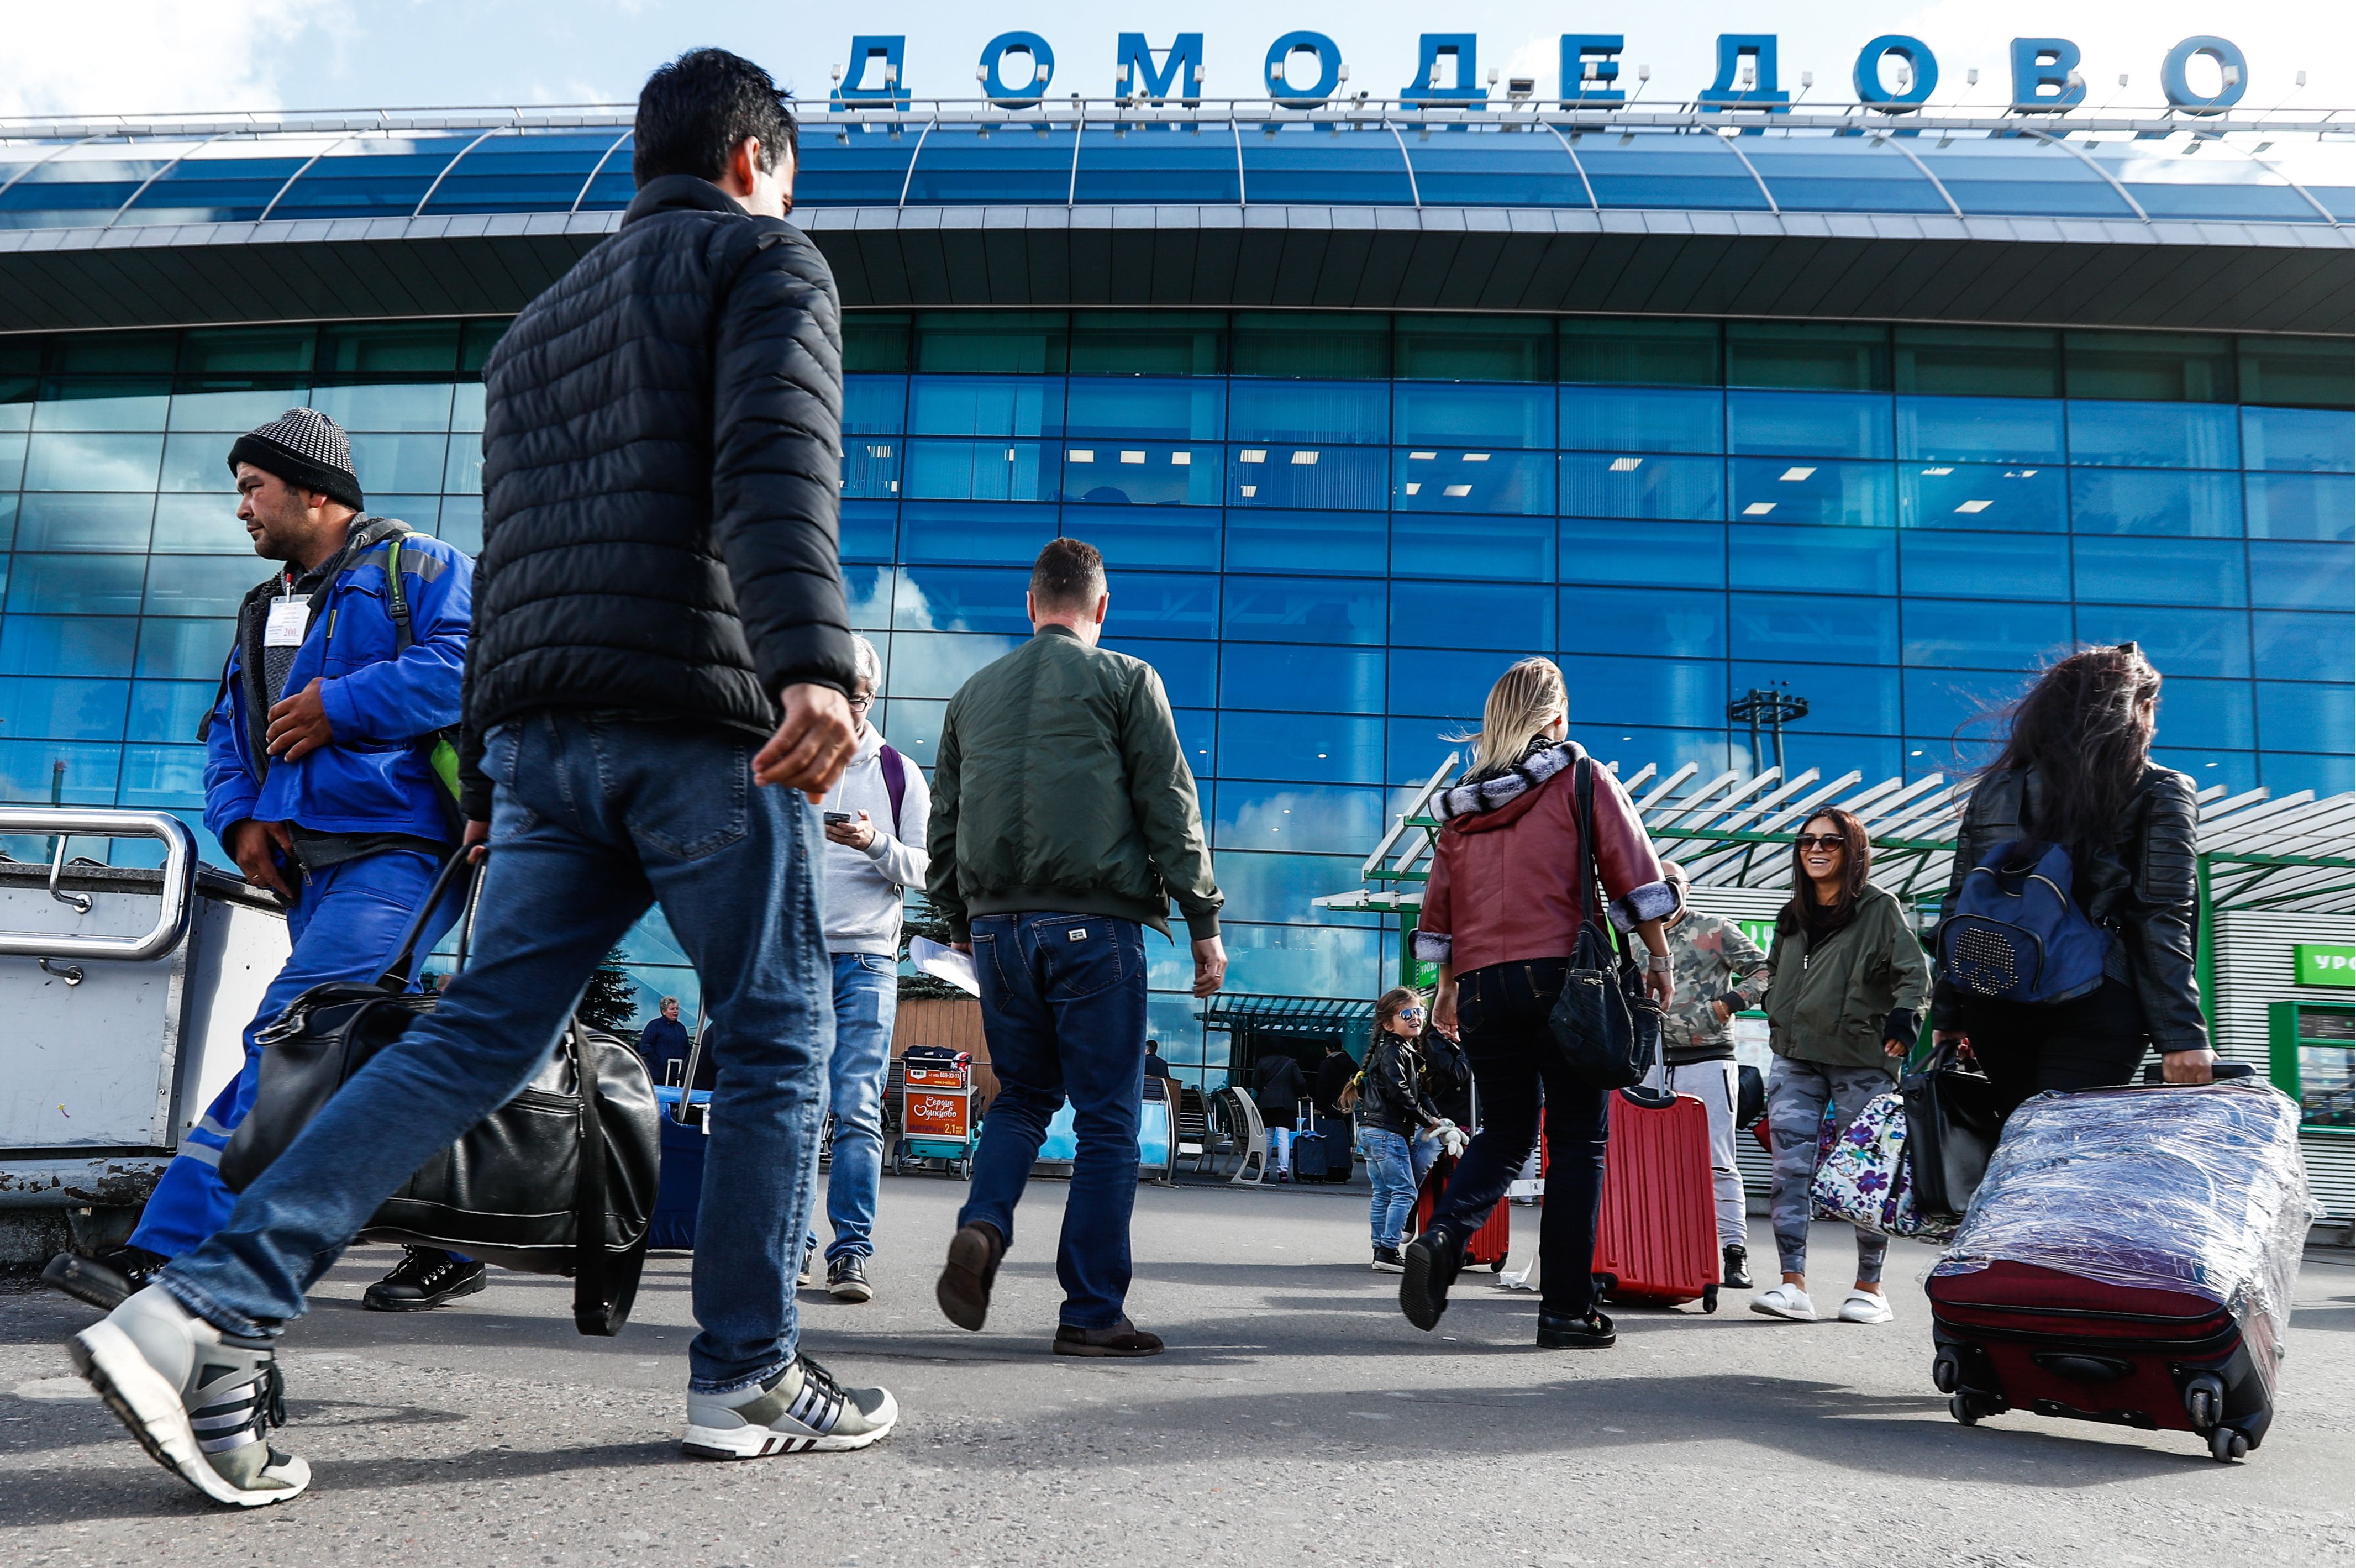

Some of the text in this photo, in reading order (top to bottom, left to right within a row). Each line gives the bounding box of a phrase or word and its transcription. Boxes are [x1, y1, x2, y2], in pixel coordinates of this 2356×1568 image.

[830, 30, 2248, 116] ДОМОДЕДОВО
[925, 1095, 954, 1111] Сердце
[945, 1123, 955, 1134] 2,1
